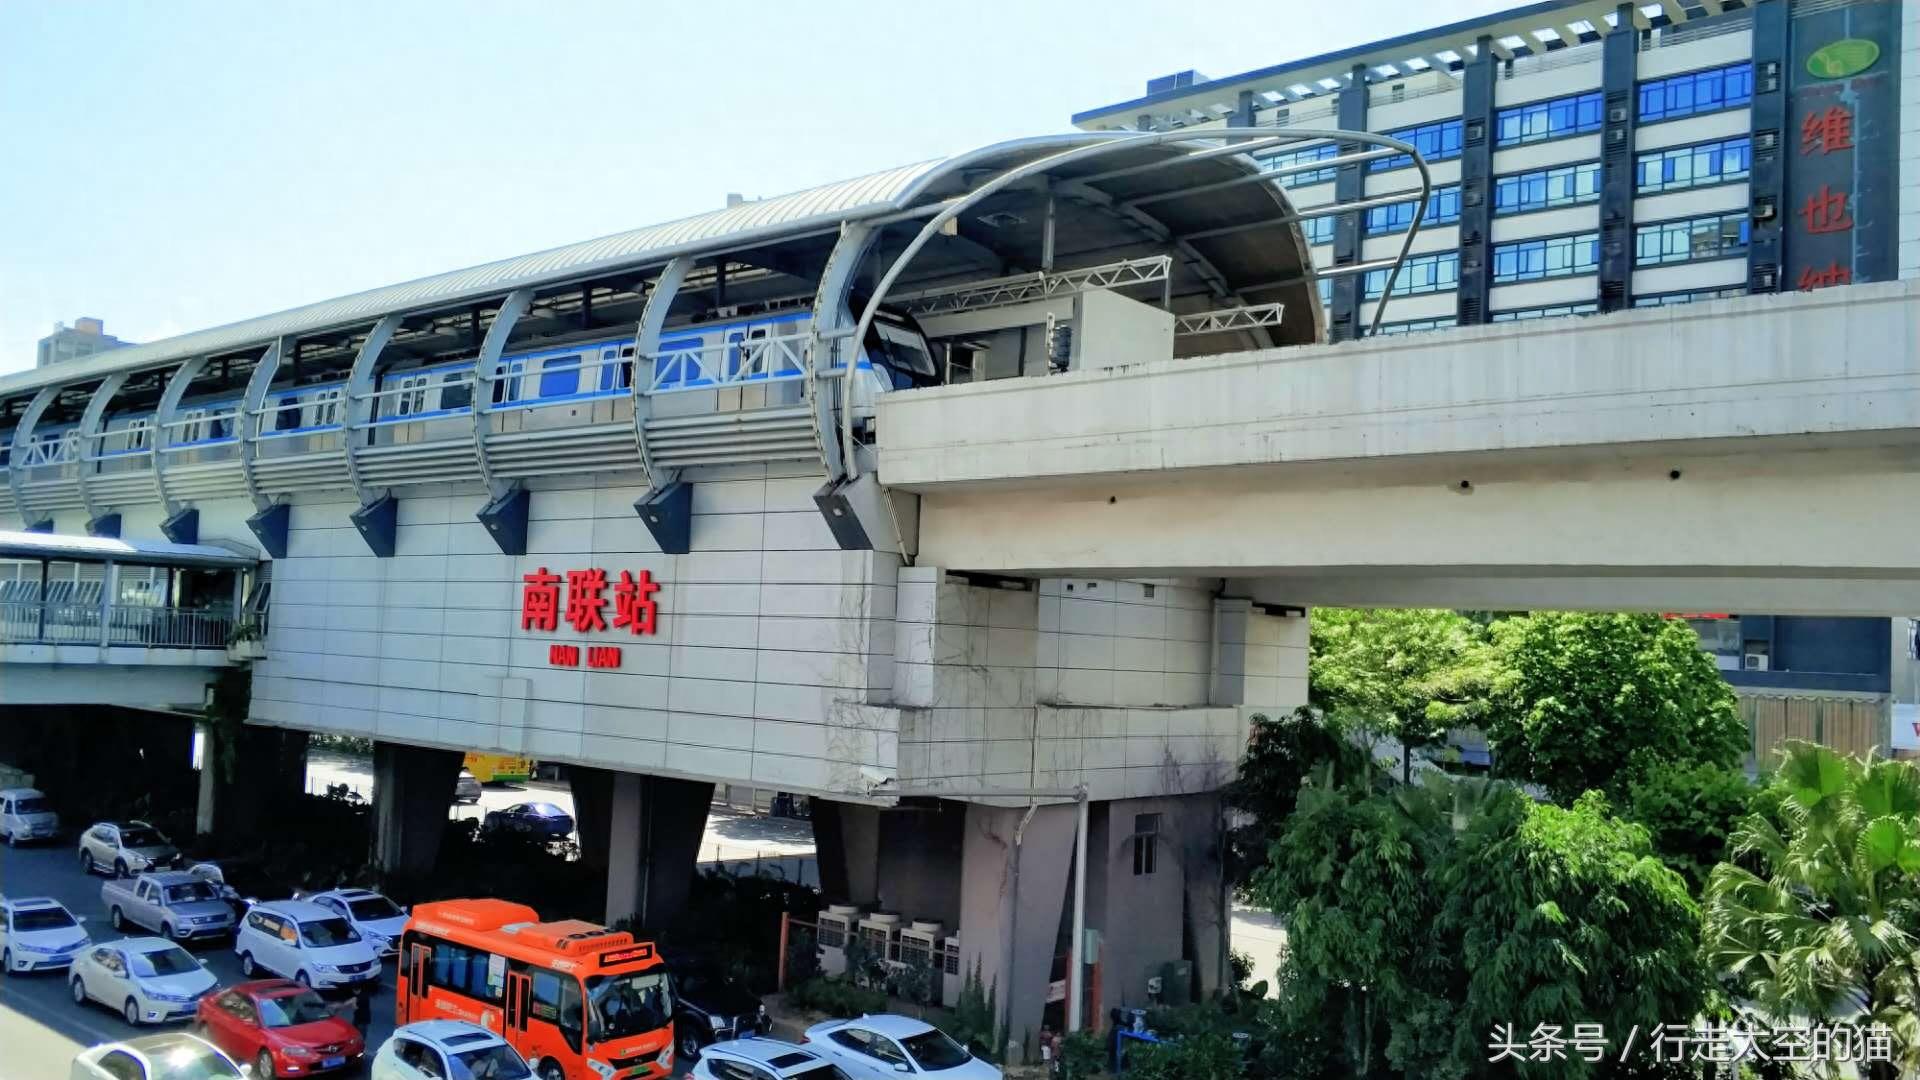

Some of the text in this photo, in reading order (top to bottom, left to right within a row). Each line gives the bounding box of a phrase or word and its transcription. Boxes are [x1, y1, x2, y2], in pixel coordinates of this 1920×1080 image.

[521, 567, 661, 635] 南联站
[549, 644, 622, 668] NAN LIAN
